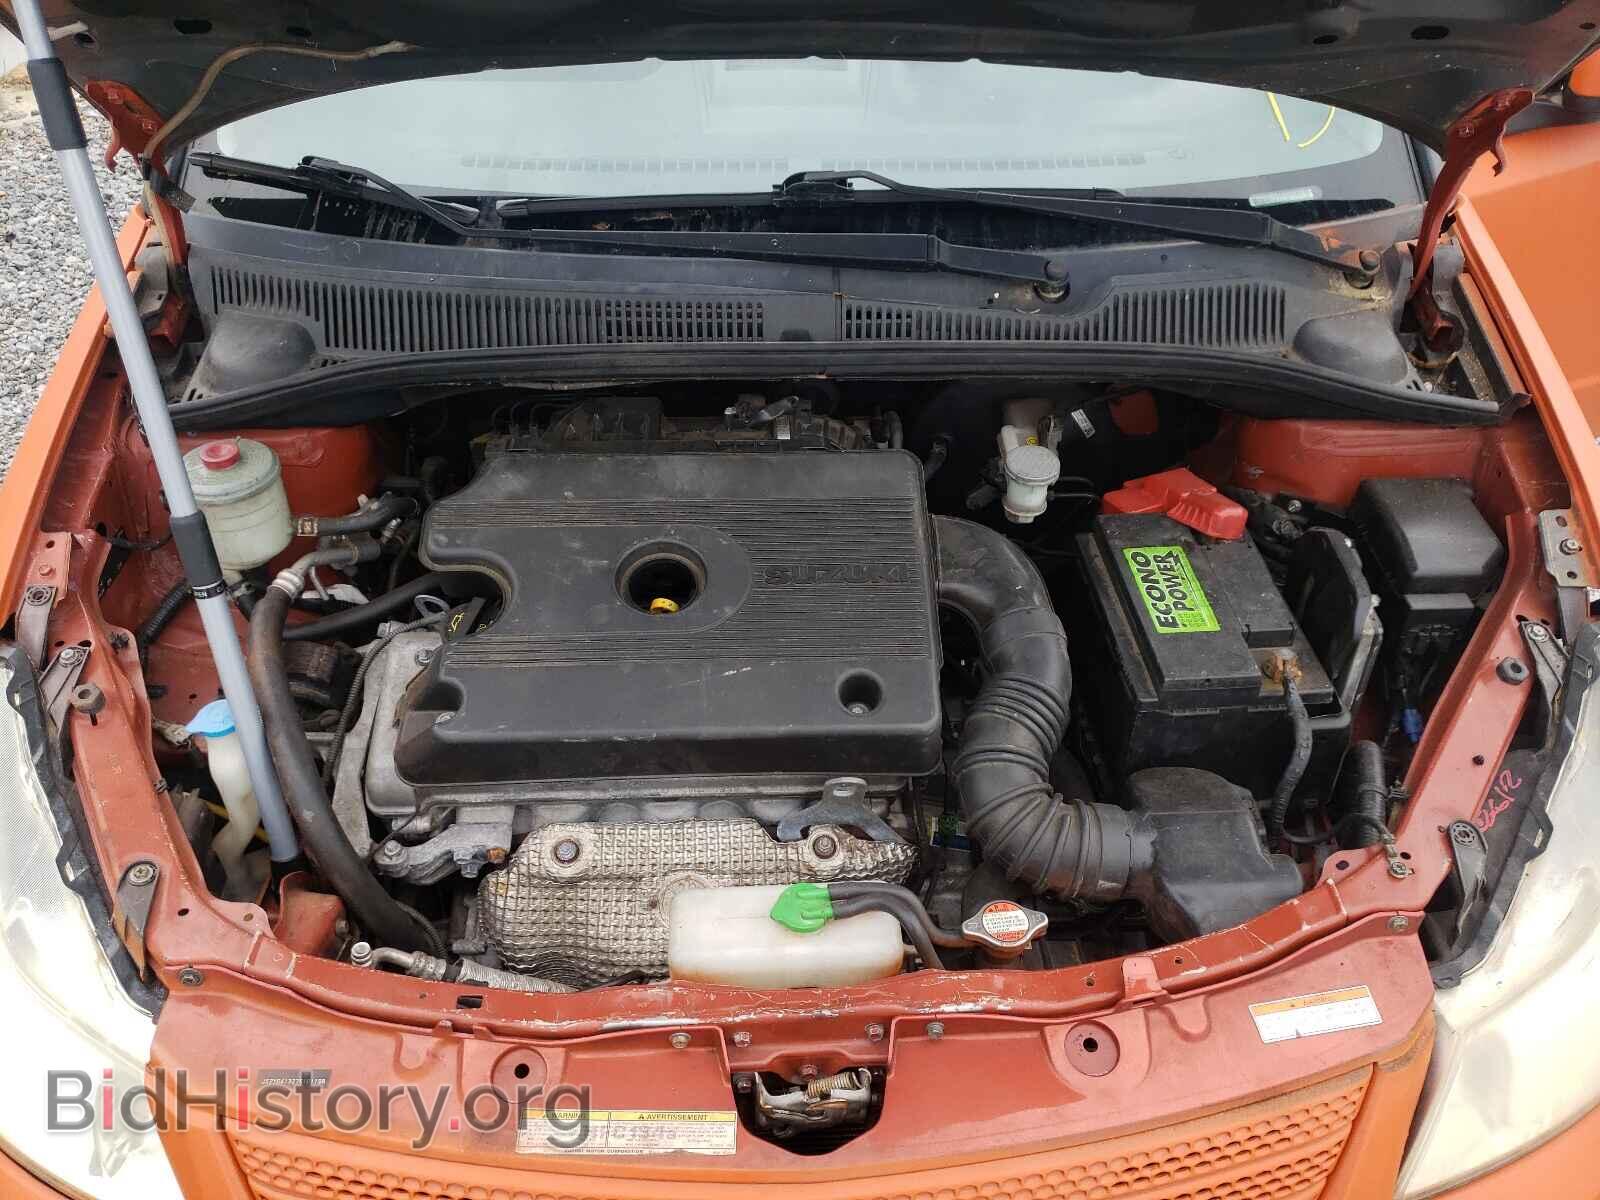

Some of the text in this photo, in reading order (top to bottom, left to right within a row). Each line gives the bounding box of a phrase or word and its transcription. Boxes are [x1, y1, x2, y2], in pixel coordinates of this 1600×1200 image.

[764, 564, 909, 585] SUZUKI
[1130, 551, 1180, 628] ECONO
[1152, 550, 1195, 612] POWER
[646, 1112, 709, 1121] AVERTISSEMENT
